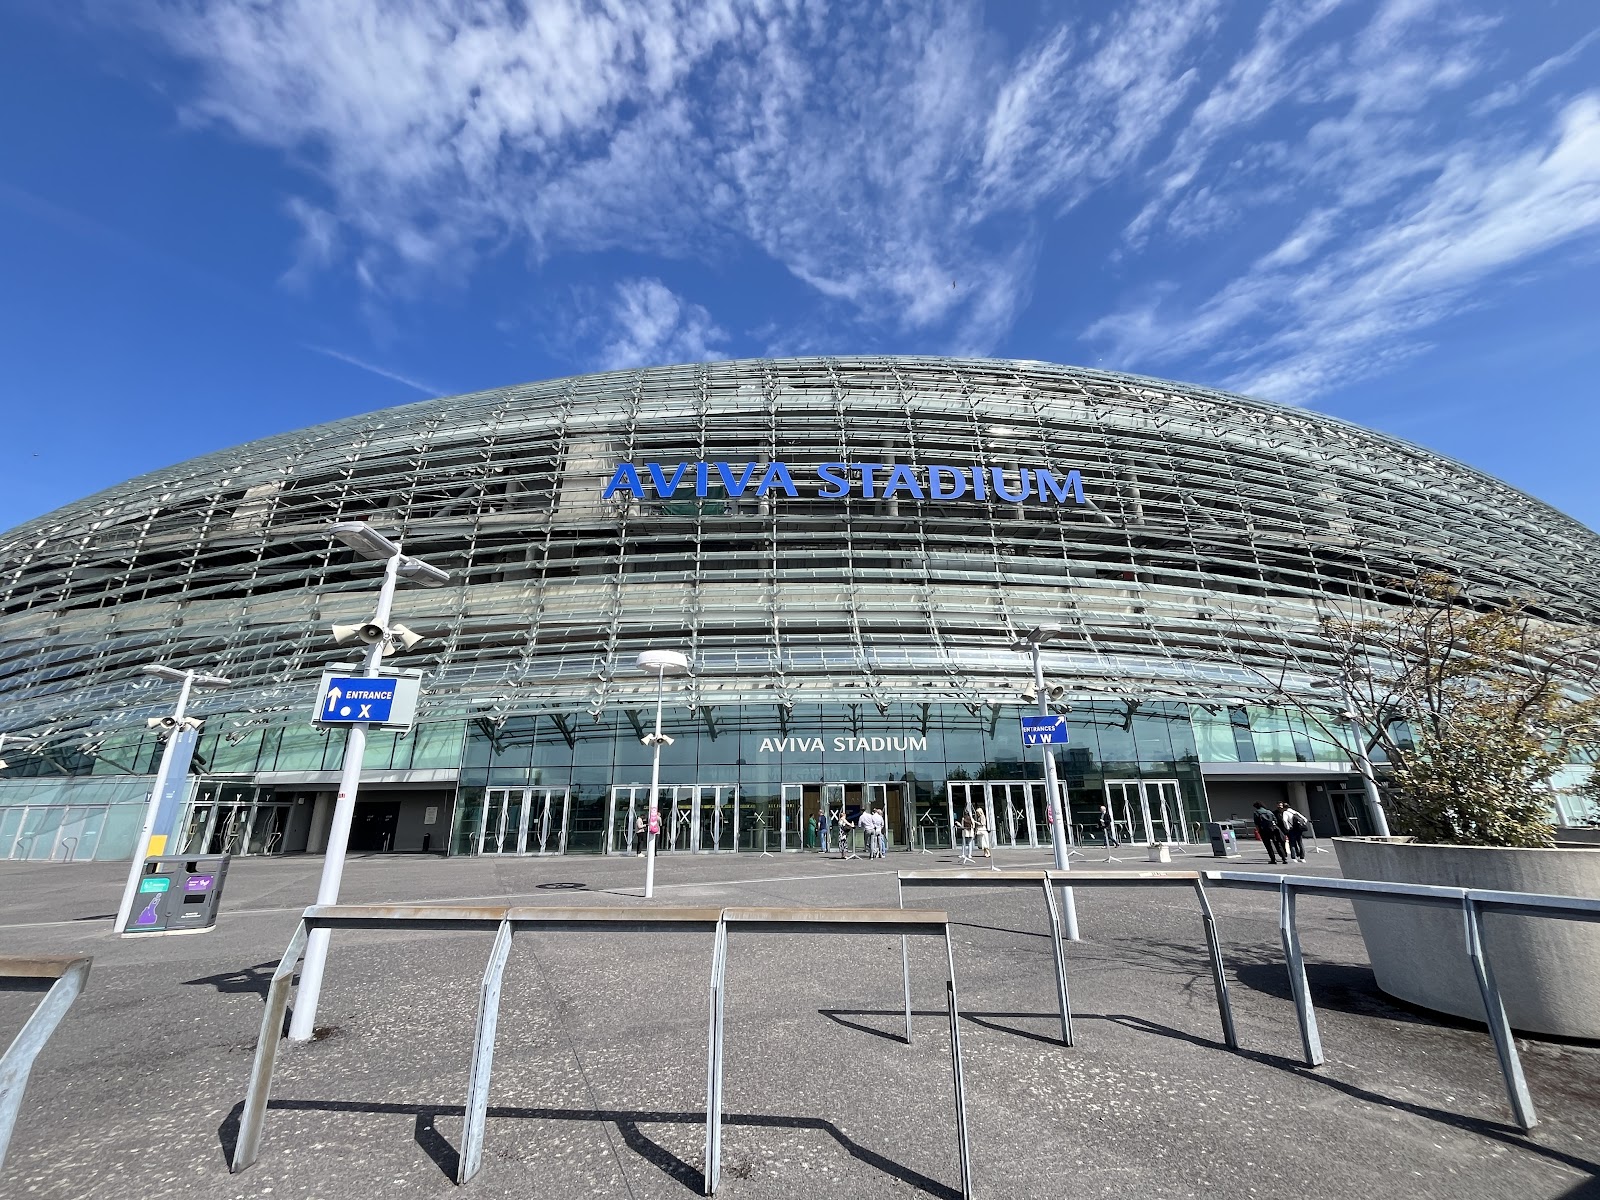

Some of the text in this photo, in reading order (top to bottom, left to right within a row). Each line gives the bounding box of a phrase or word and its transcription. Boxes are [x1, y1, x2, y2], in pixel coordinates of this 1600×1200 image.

[602, 462, 1086, 504] AVIVA STADIUM
[346, 691, 392, 700] ENTRANCE
[357, 704, 372, 718] X
[759, 736, 927, 752] AVIVA STADIUM
[1028, 734, 1051, 743] V W
